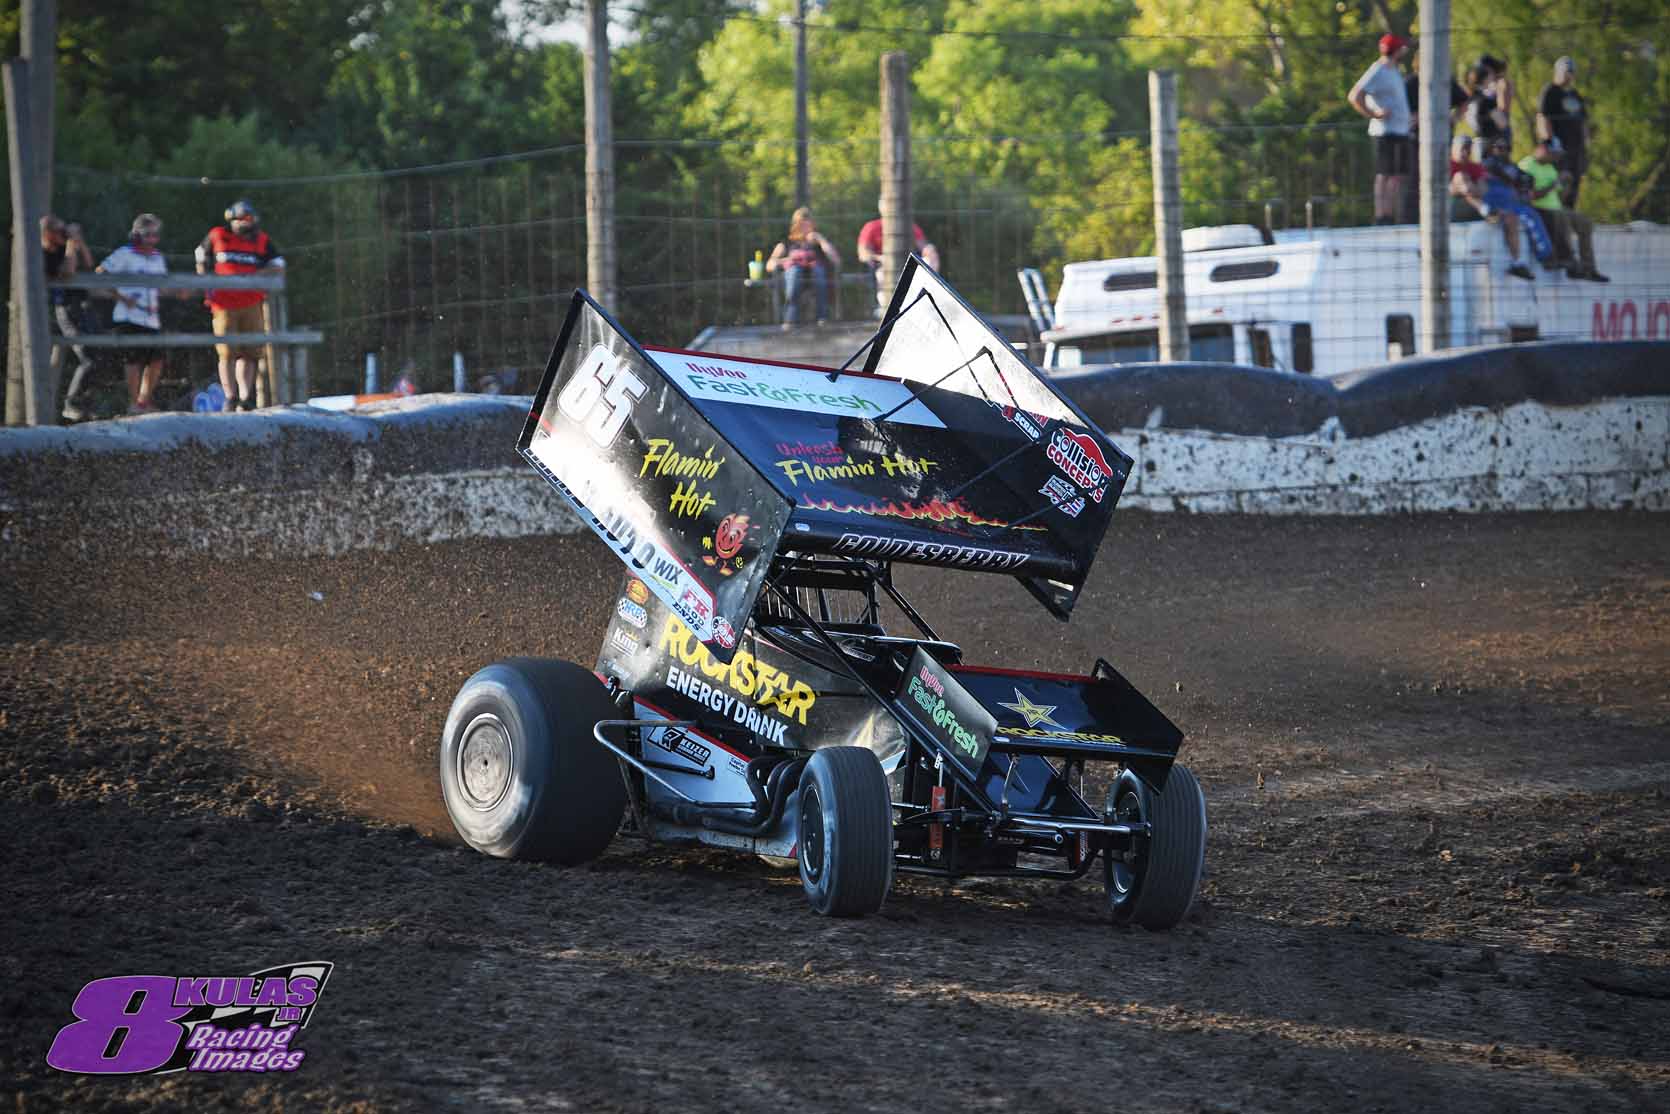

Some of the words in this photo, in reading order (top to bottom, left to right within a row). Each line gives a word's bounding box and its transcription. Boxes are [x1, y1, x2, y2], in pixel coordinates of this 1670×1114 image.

[557, 343, 649, 449] 65
[1013, 412, 1040, 439] SCRAP
[881, 456, 938, 476] Hot
[669, 481, 716, 520] Hot
[653, 558, 683, 585] WIX
[672, 602, 700, 631] ENDS
[666, 665, 735, 721] ENERGY
[734, 703, 788, 746] DRINK
[680, 738, 710, 757] KEIZER
